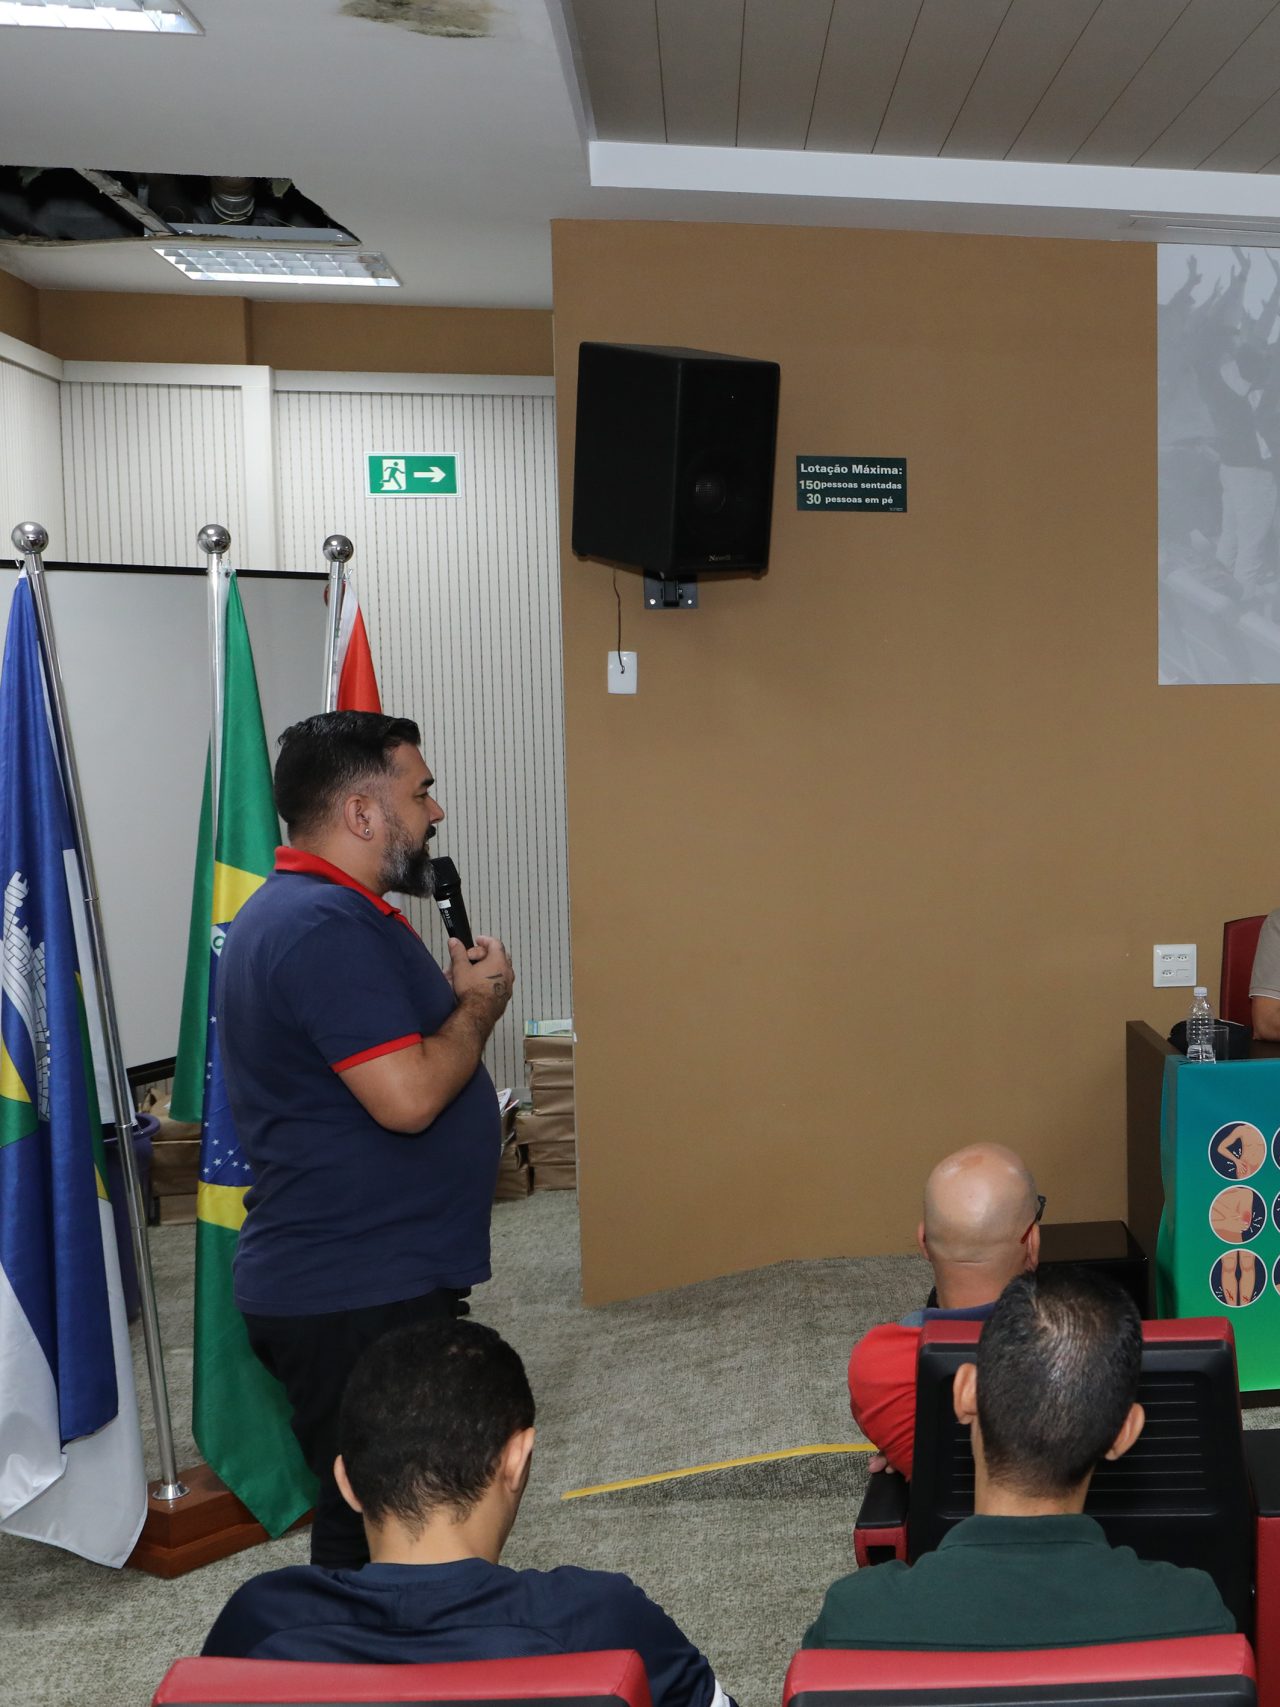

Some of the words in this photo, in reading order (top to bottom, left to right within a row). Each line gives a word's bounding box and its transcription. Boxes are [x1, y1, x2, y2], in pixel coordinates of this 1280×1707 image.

[801, 463, 848, 475] Lotação
[852, 464, 903, 475] Máxima:
[806, 494, 821, 504] 30
[882, 496, 893, 505] pé
